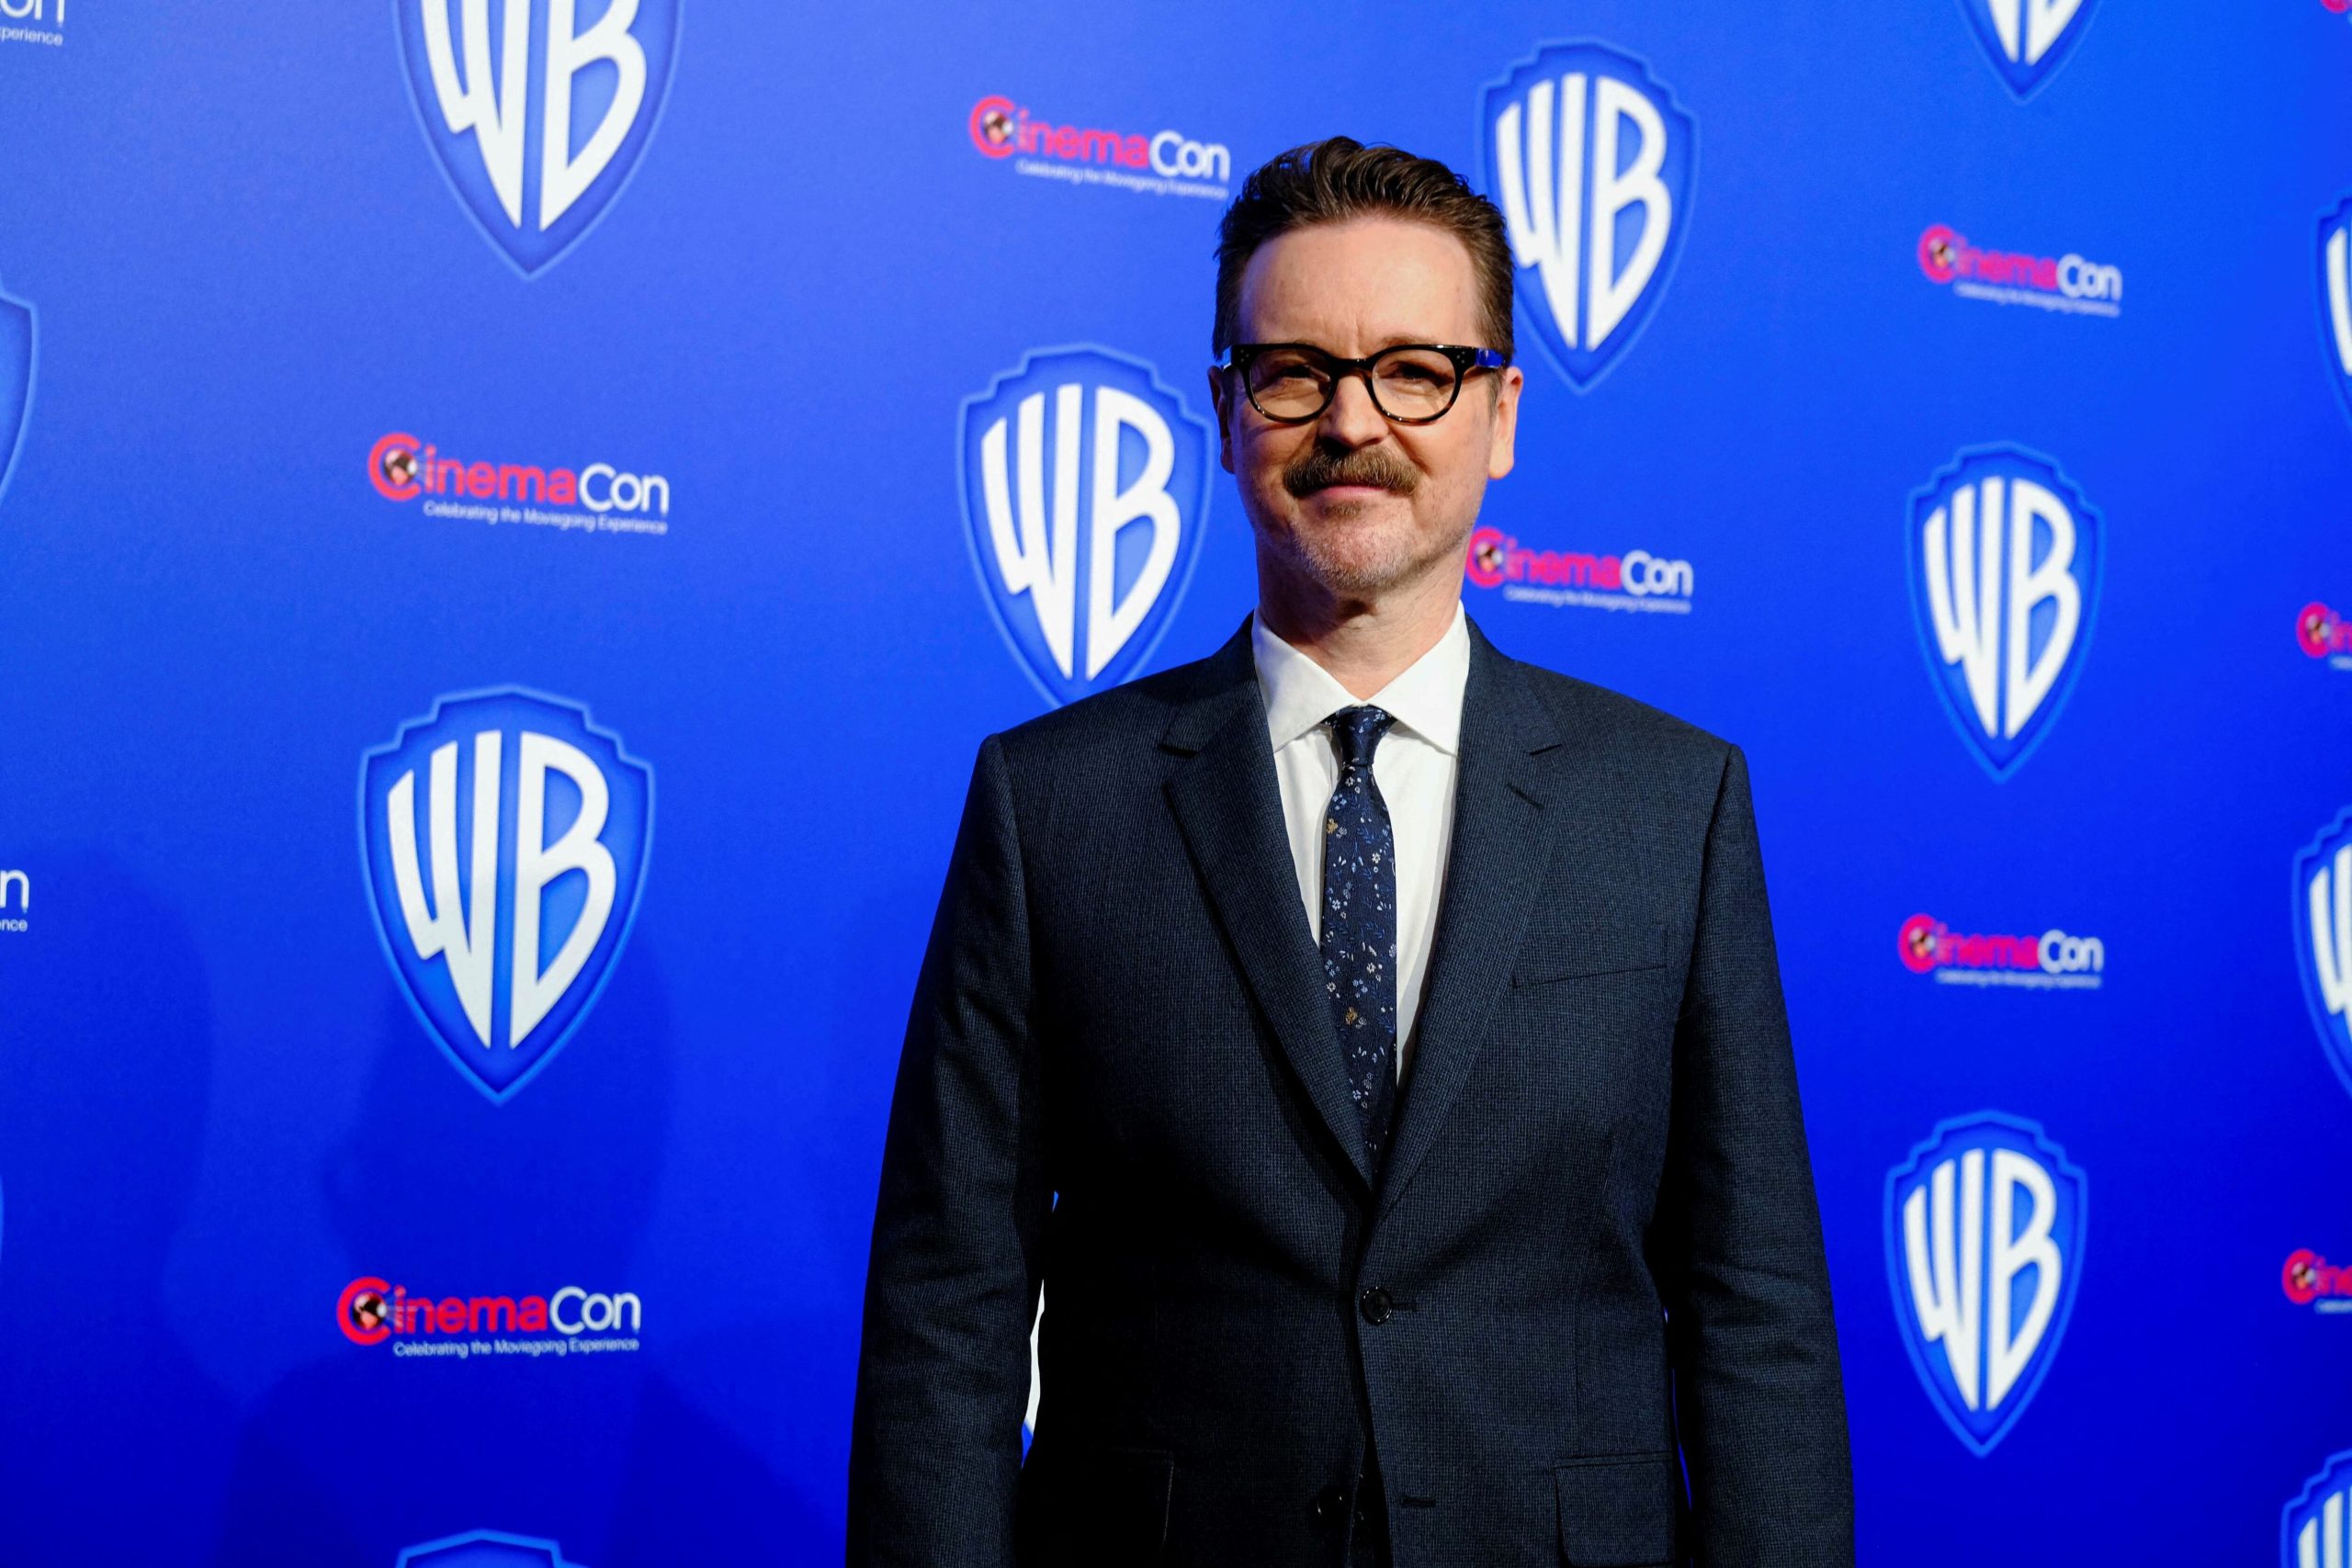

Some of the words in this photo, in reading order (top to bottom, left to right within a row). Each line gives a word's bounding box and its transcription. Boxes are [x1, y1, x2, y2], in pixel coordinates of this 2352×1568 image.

[969, 96, 1231, 183] CinemaCon
[1496, 73, 1672, 352] WB
[368, 433, 670, 516] CinemaCon
[981, 383, 1182, 682] WB
[1923, 476, 2081, 739] WB
[388, 730, 616, 1049] WB
[336, 1276, 641, 1346] CinemaCon
[393, 1340, 469, 1359] Celebrating
[470, 1339, 492, 1355] the
[494, 1338, 568, 1357] Moviegoing
[569, 1337, 640, 1355] Experience
[1904, 1147, 2063, 1412] WB
